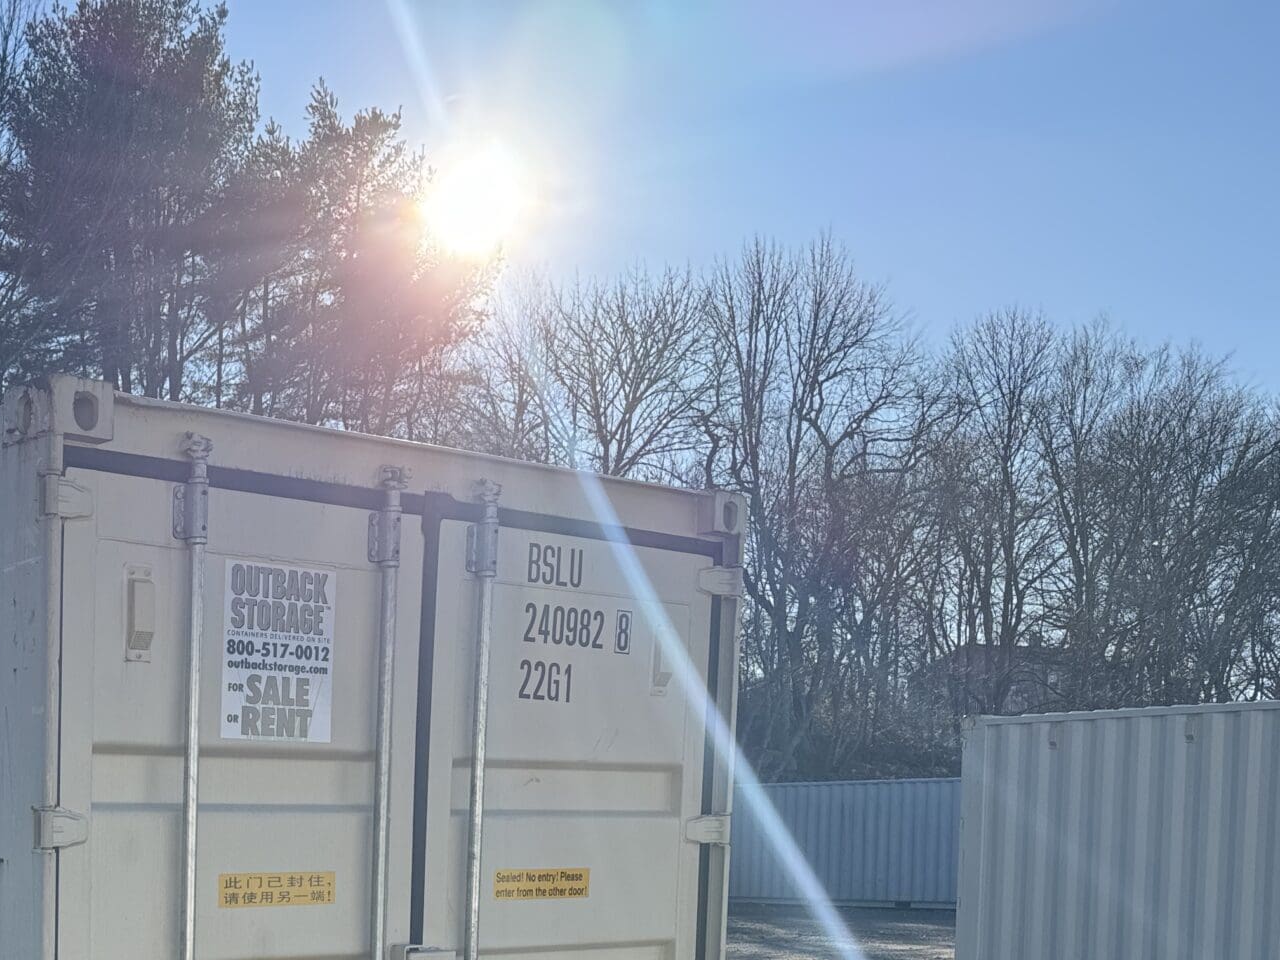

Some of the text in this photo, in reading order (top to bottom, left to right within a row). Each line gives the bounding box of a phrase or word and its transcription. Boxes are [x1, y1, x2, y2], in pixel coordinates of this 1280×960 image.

[527, 542, 584, 588] BSLU
[231, 563, 329, 605] OUTBACK
[230, 597, 325, 636] STORAGE
[523, 602, 630, 652] 240982 8
[226, 638, 330, 662] 800-517-0012
[227, 629, 268, 639] CONTAINERS
[269, 633, 304, 642] DELIVERED
[227, 657, 328, 675] outbackstorage.com
[518, 659, 572, 702] 22G1
[227, 673, 310, 708] FOR SALE
[226, 705, 313, 739] OR RENT
[495, 871, 583, 884] Sealed! No entry! Please
[495, 888, 515, 898] enter
[516, 887, 534, 897] from
[535, 886, 547, 897] the
[548, 886, 567, 897] other
